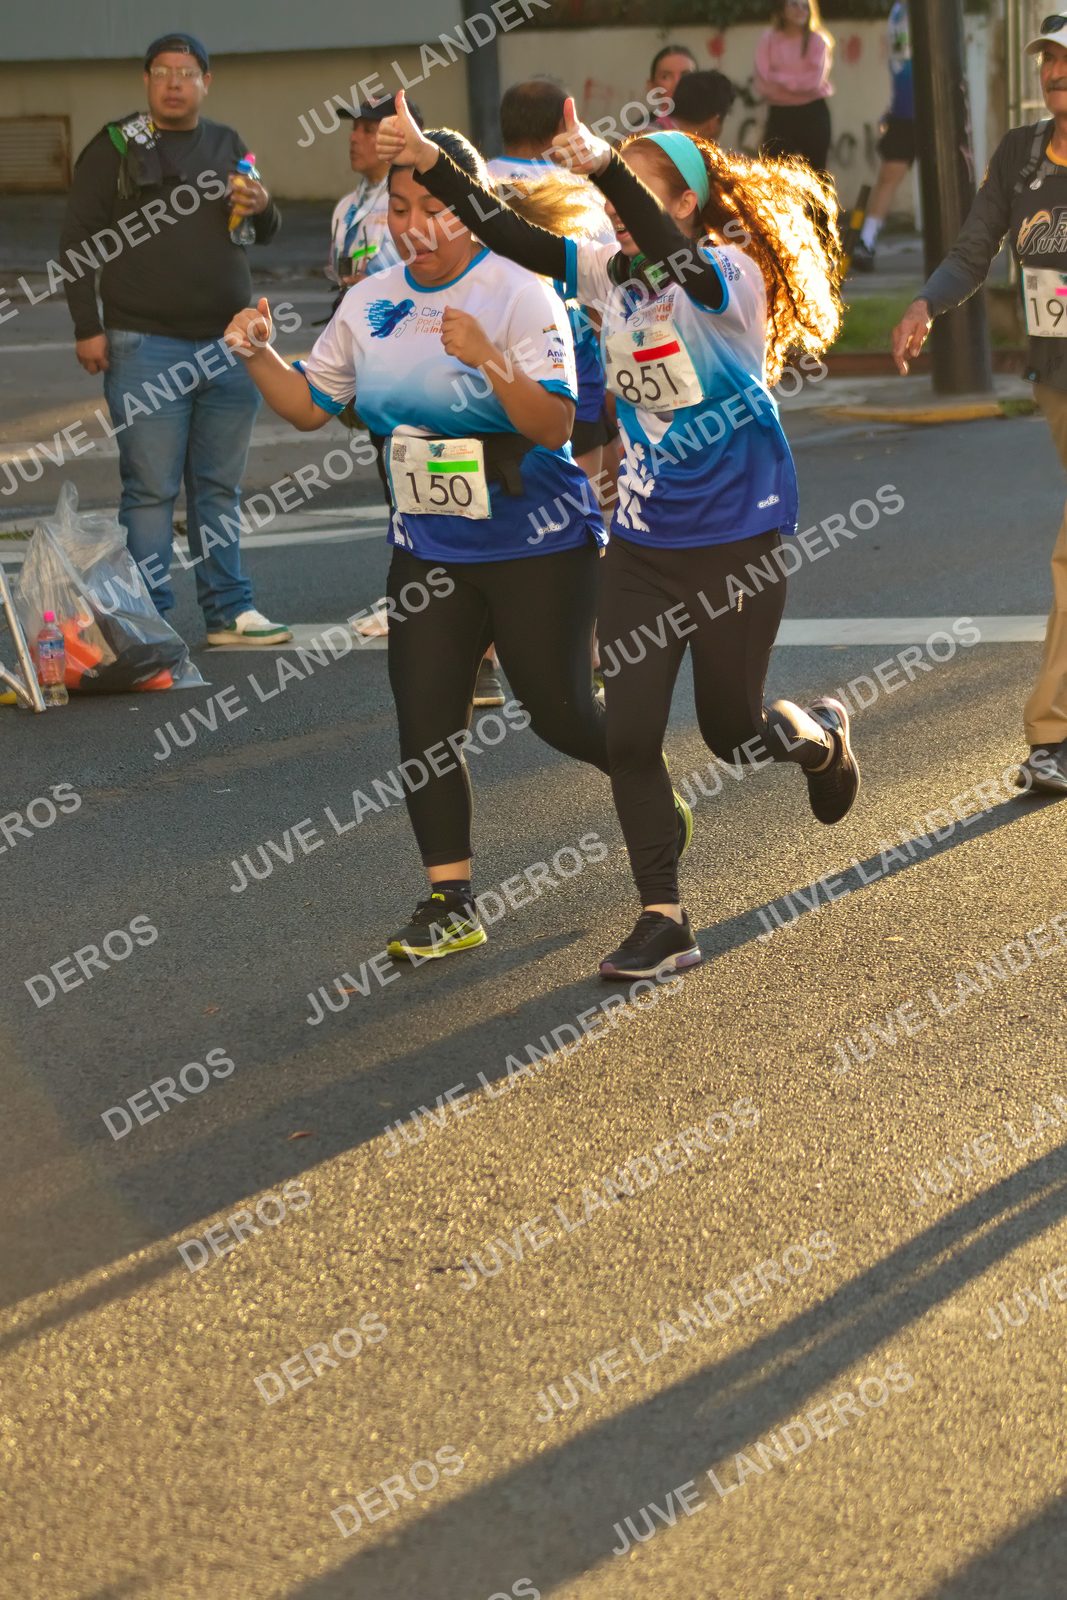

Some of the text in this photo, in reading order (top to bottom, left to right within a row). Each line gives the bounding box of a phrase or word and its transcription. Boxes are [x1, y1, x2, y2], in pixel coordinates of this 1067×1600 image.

[1030, 297, 1067, 328] 19
[616, 362, 679, 404] 851
[405, 472, 472, 507] 150
